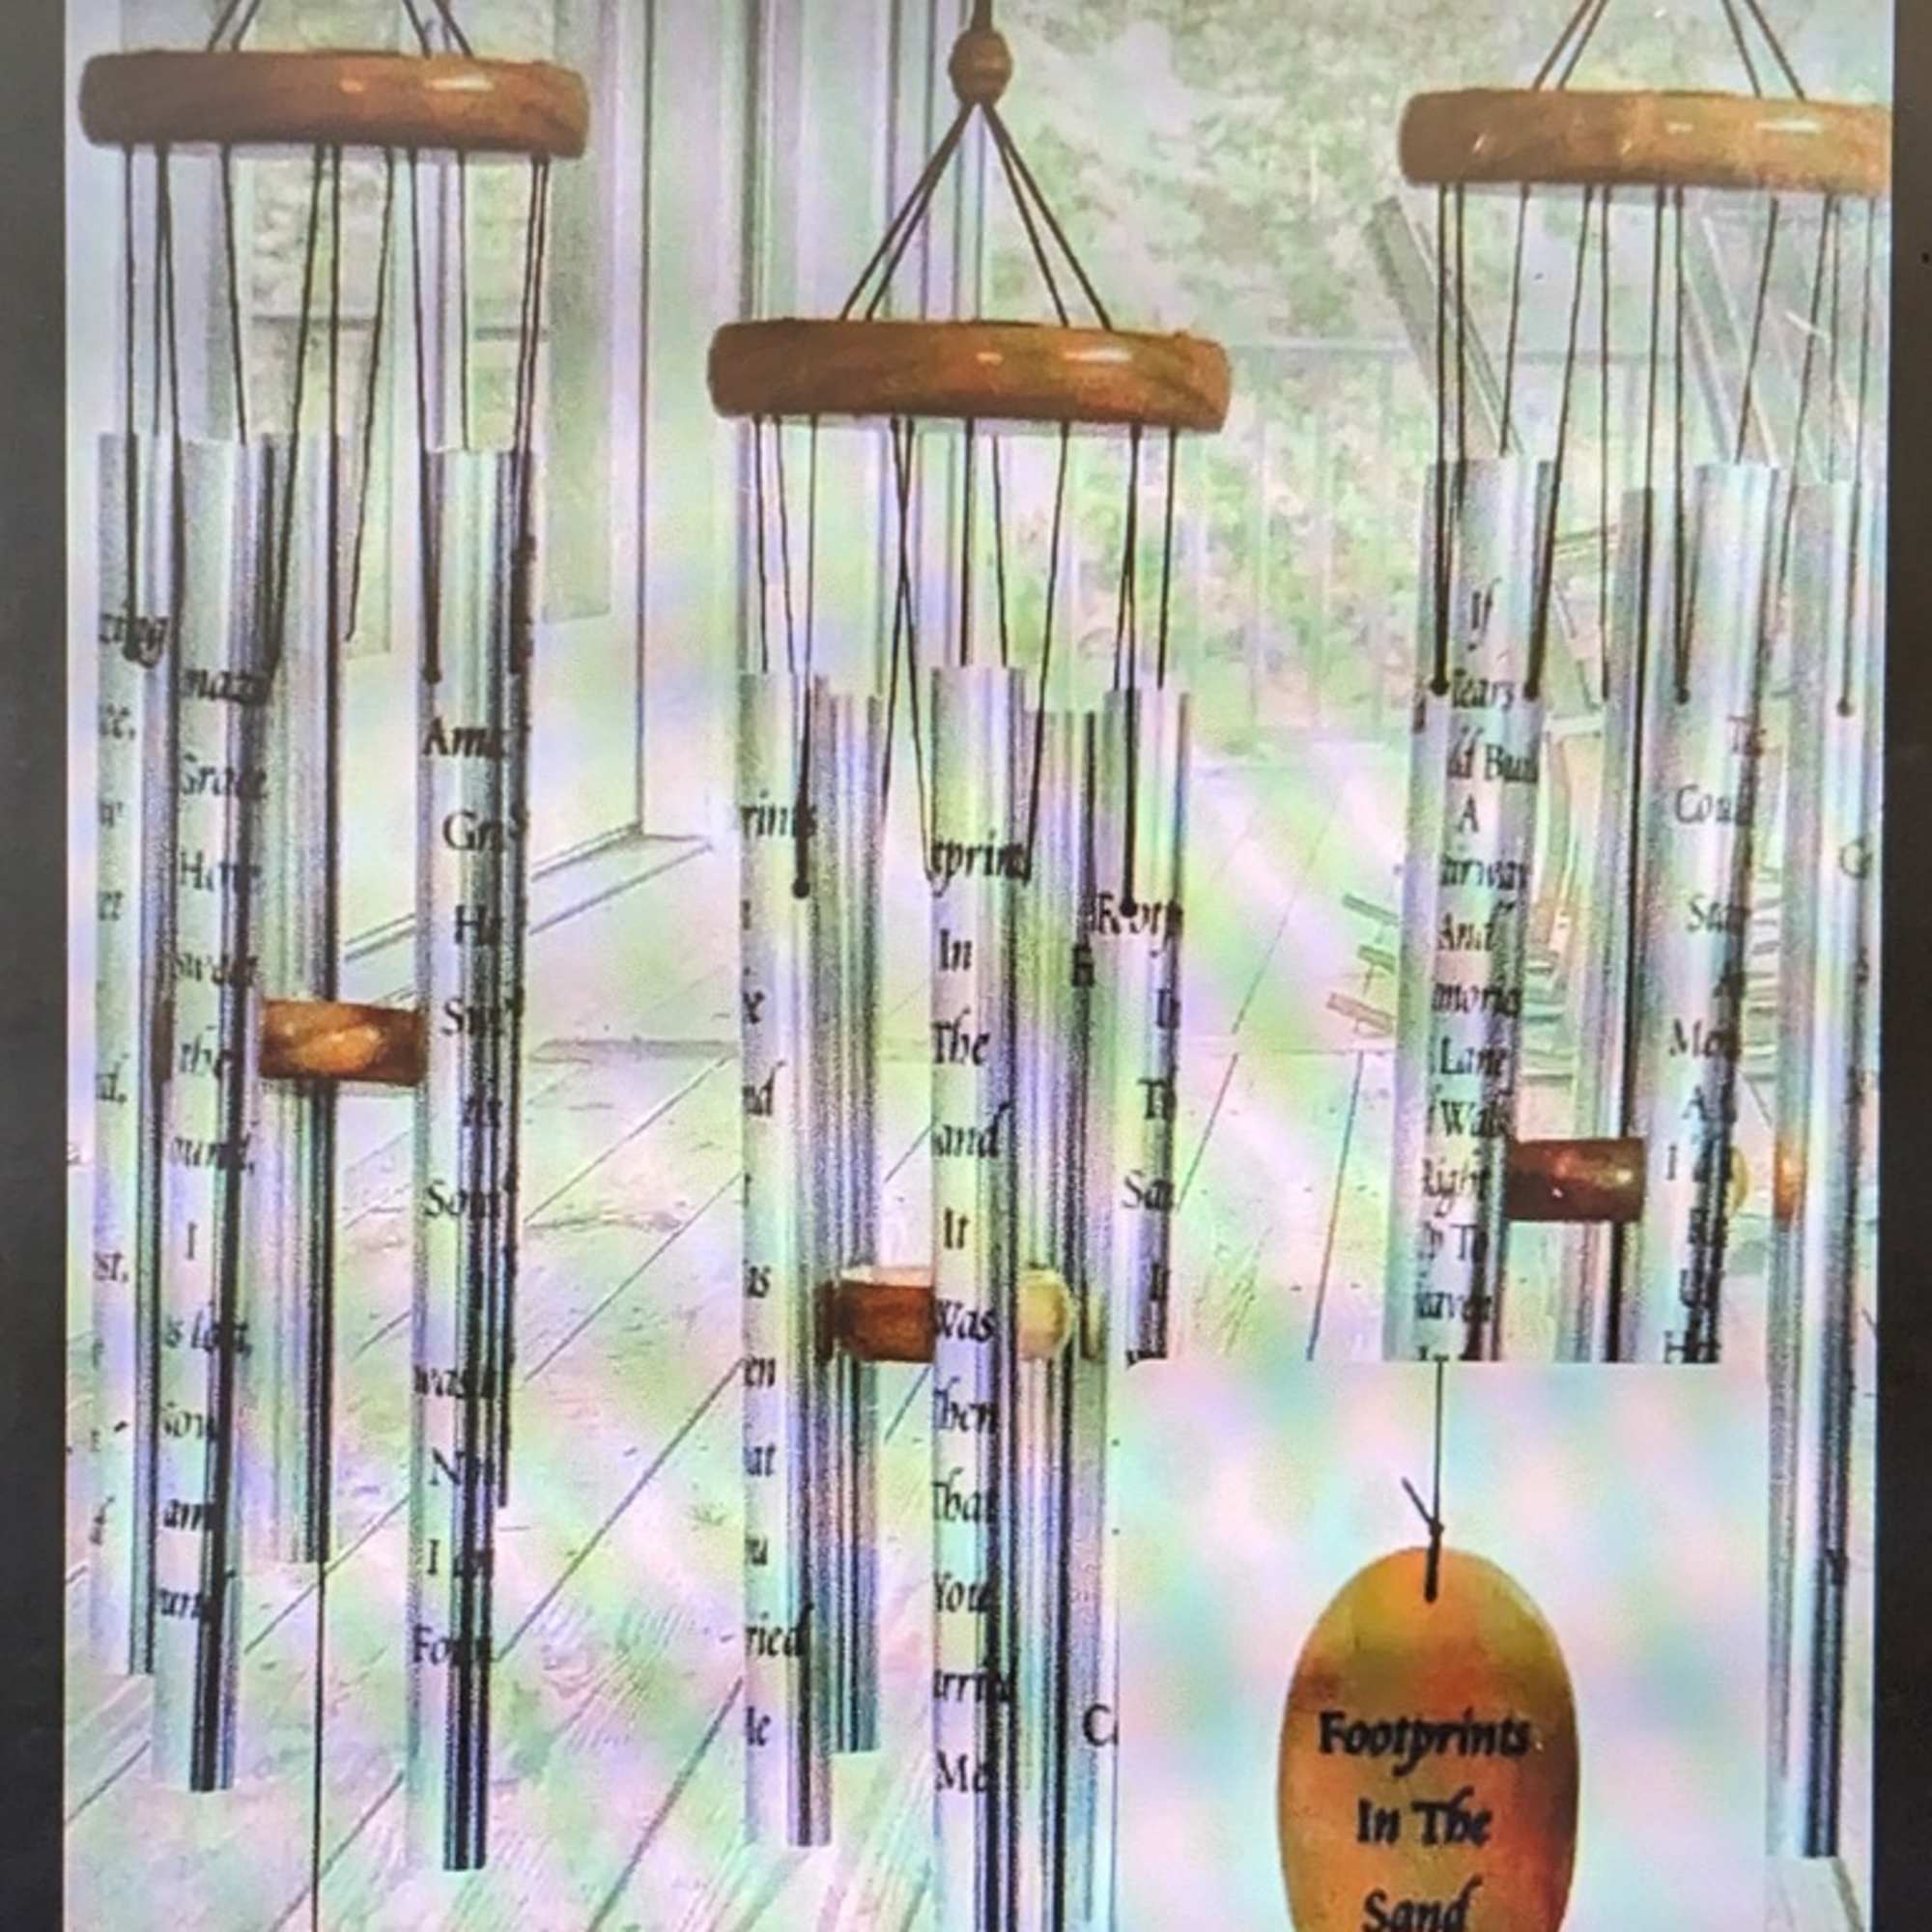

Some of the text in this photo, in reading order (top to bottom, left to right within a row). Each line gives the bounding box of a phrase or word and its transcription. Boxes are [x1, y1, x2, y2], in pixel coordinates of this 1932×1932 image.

[940, 928, 972, 972] In
[930, 1008, 990, 1065] The
[931, 1101, 1012, 1158] and
[943, 1208, 971, 1250] It
[1319, 1705, 1534, 1778] Footprints
[1356, 1784, 1493, 1848] In The
[1361, 1874, 1483, 1932] Sand
